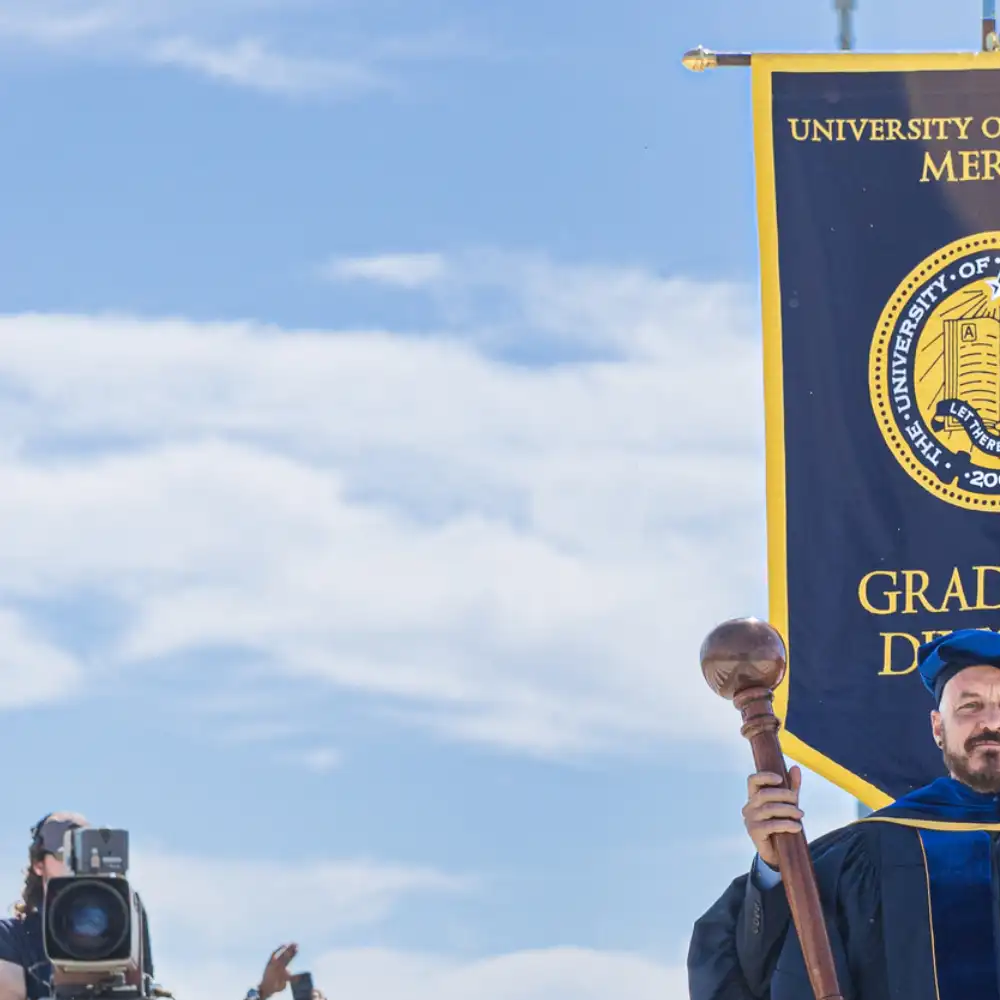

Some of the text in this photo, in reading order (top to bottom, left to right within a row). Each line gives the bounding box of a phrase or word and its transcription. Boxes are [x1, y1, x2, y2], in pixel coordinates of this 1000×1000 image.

[788, 116, 973, 142] UNIVERSITY
[958, 255, 991, 280] OF
[963, 326, 975, 339] A
[891, 274, 948, 419] UNIVERSITY
[949, 401, 974, 422] LET
[905, 420, 942, 466] THE
